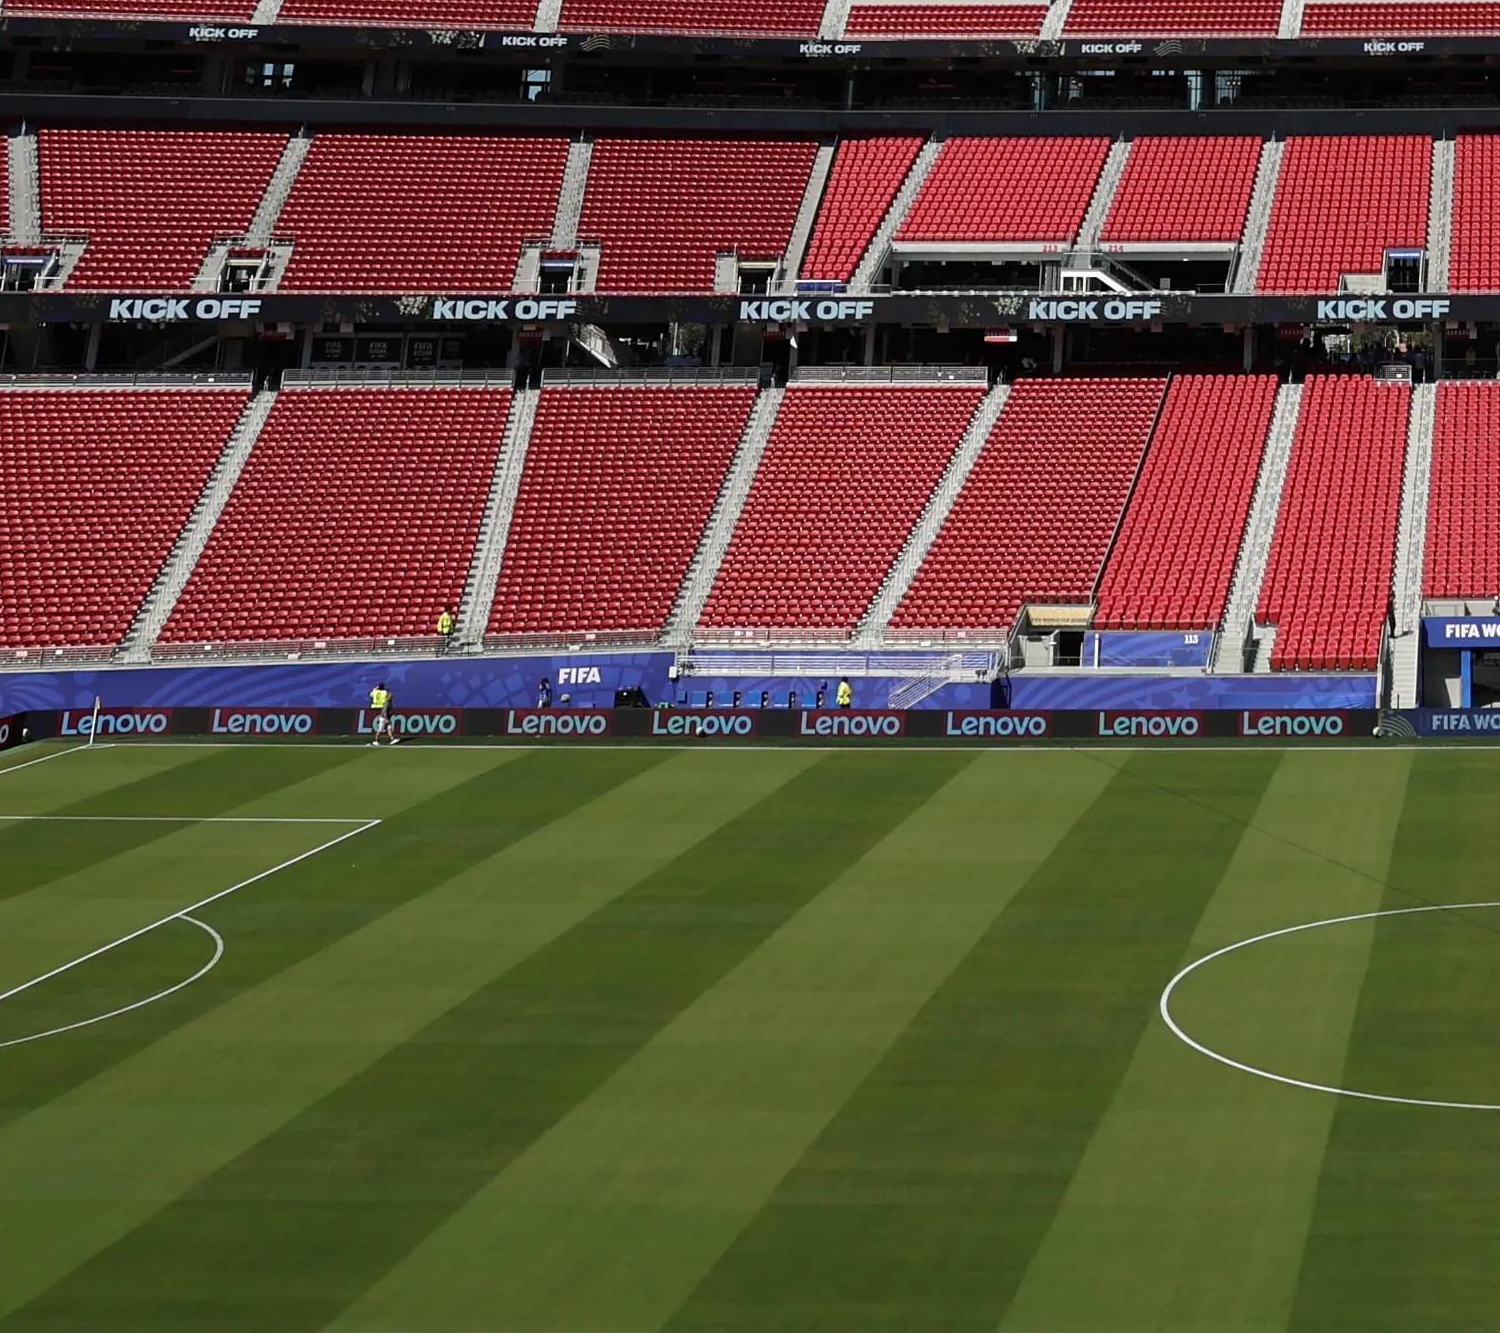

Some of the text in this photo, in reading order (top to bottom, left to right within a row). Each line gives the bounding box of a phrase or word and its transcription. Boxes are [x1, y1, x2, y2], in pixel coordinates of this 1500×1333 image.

[503, 35, 567, 46] KICK OFF
[110, 299, 261, 321] KICK OFF
[433, 298, 577, 319] KICK OFF
[740, 300, 873, 323] KICK OFF
[1029, 298, 1161, 319] KICK OFF
[1318, 300, 1450, 320] KICK OFF
[1185, 636, 1198, 644] 113
[1446, 624, 1478, 638] FIFA
[559, 667, 601, 684] FIFA
[62, 711, 166, 734] Lenovo
[214, 709, 311, 732] Lenovo
[358, 709, 455, 733] Lenovo
[510, 710, 605, 733] Lenovo
[654, 711, 752, 733] Lenovo
[803, 711, 899, 733] Lenovo
[947, 712, 1047, 735] Lenovo
[1100, 712, 1196, 734] Lenovo
[1242, 712, 1342, 733] Lenovo
[1432, 715, 1471, 730] FIFA
